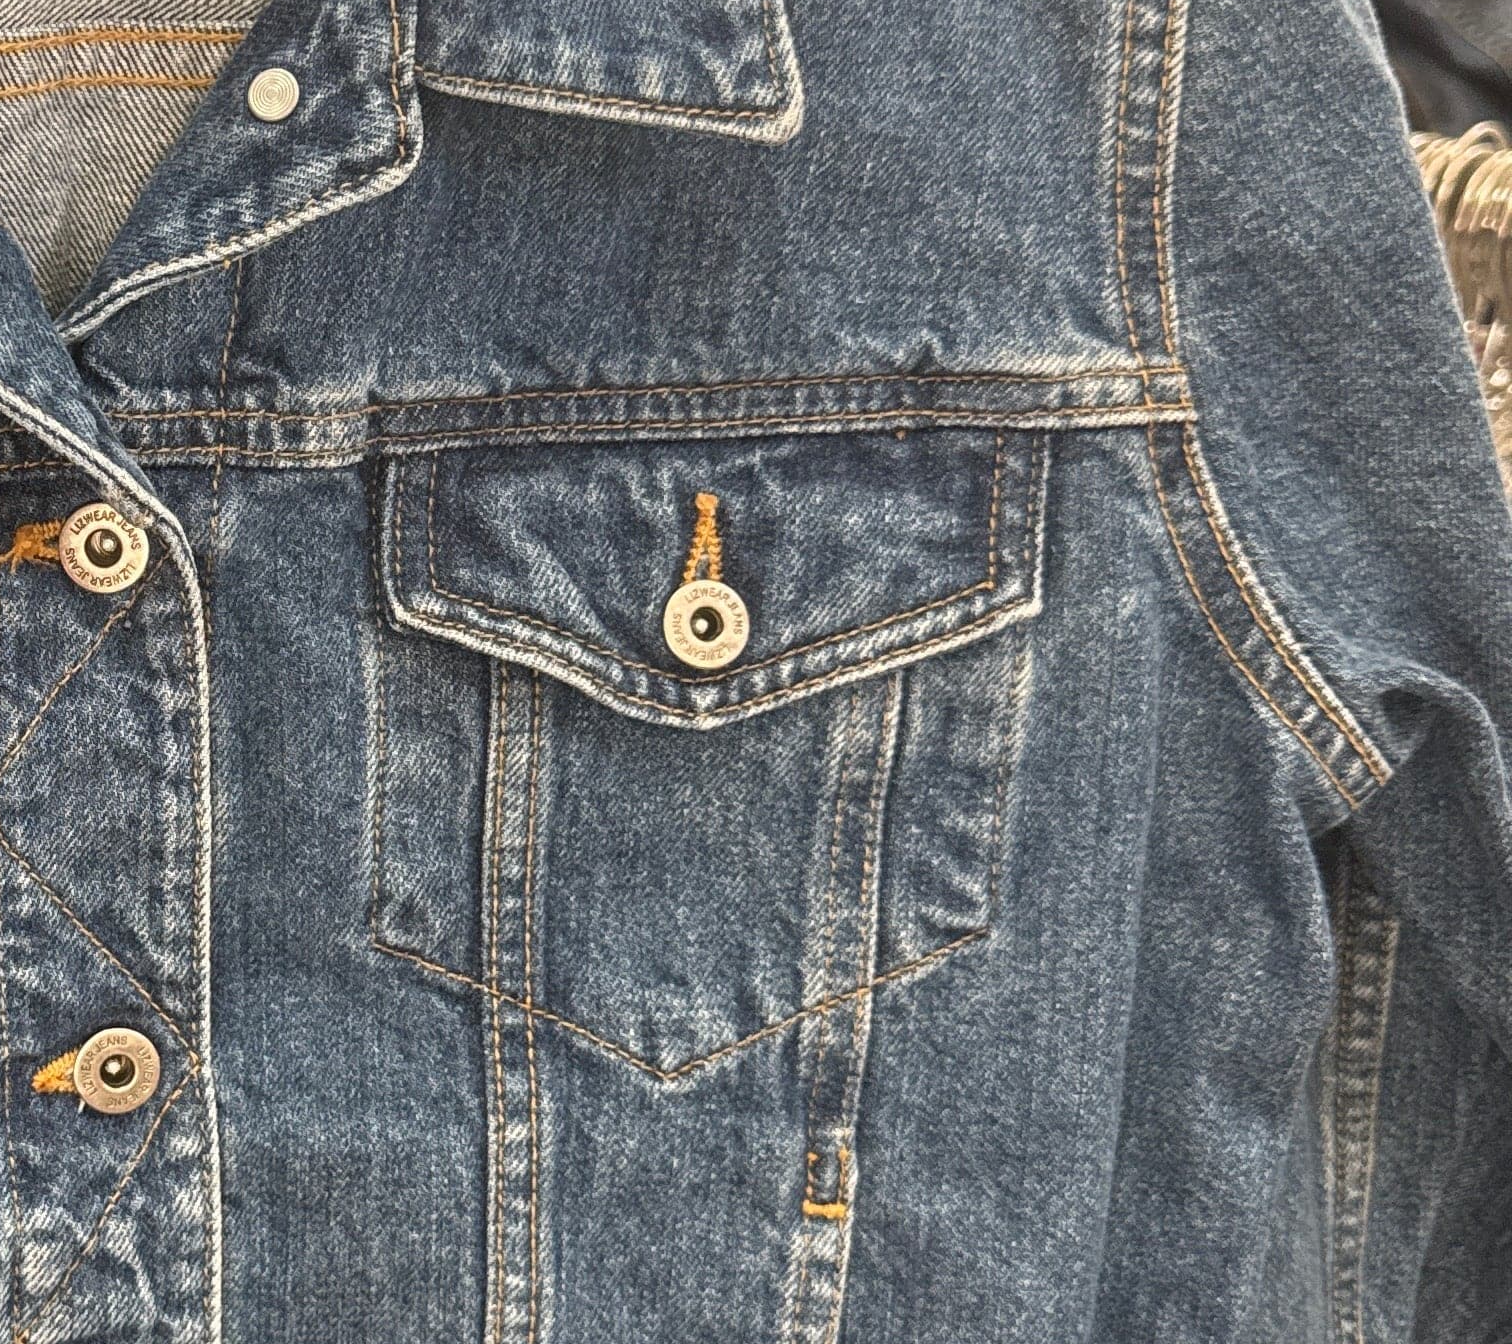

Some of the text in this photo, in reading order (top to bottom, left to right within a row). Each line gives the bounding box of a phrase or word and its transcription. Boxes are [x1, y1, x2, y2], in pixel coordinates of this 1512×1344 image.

[70, 510, 142, 550] LIZWEAR JEANS
[65, 547, 136, 587] LIZWEAR JEANS
